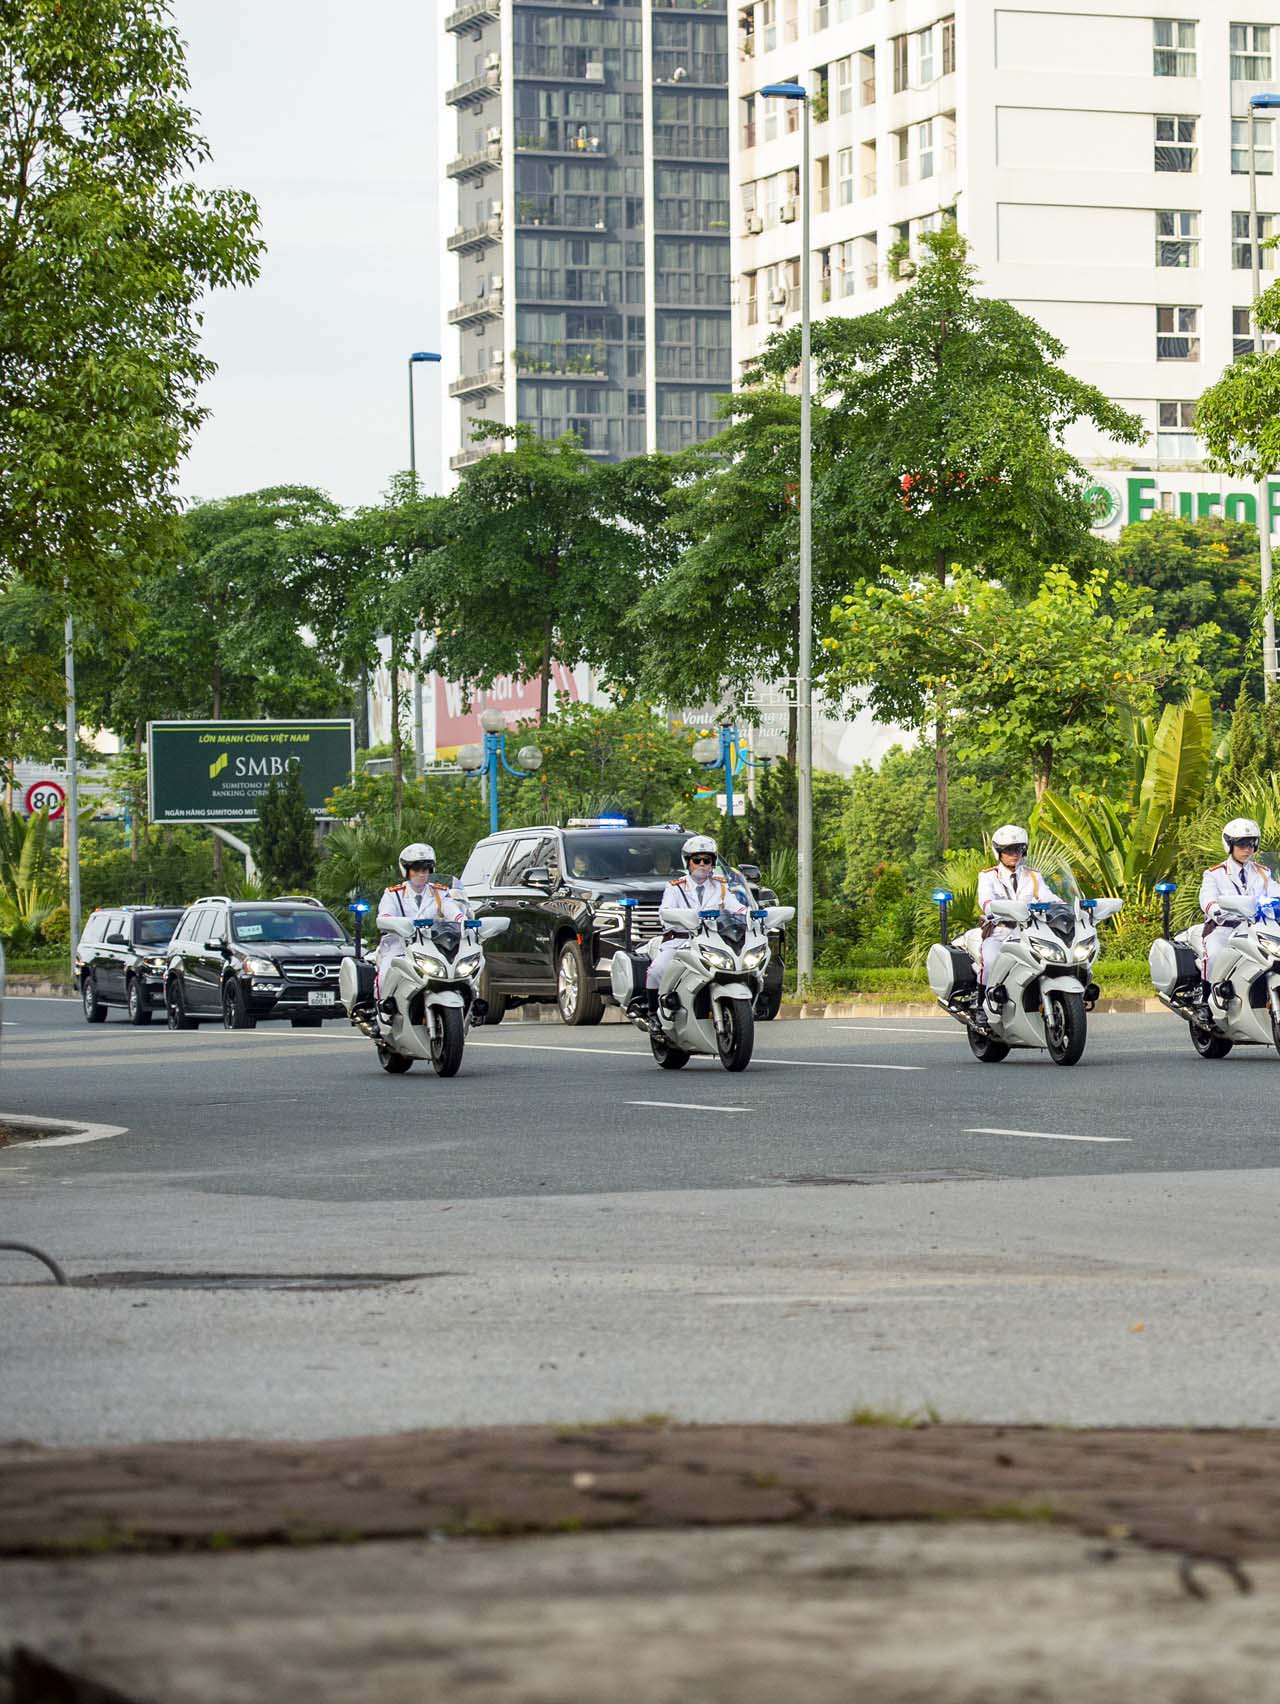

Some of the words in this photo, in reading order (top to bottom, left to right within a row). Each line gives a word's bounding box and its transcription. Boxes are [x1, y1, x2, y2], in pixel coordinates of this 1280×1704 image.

[198, 733, 216, 743] LỚN
[217, 734, 244, 744] MẠNH
[245, 732, 269, 743] CÙNG
[270, 732, 290, 744] VIỆT
[290, 733, 310, 743] NAM
[212, 789, 245, 797] BANKING
[33, 792, 58, 810] 80
